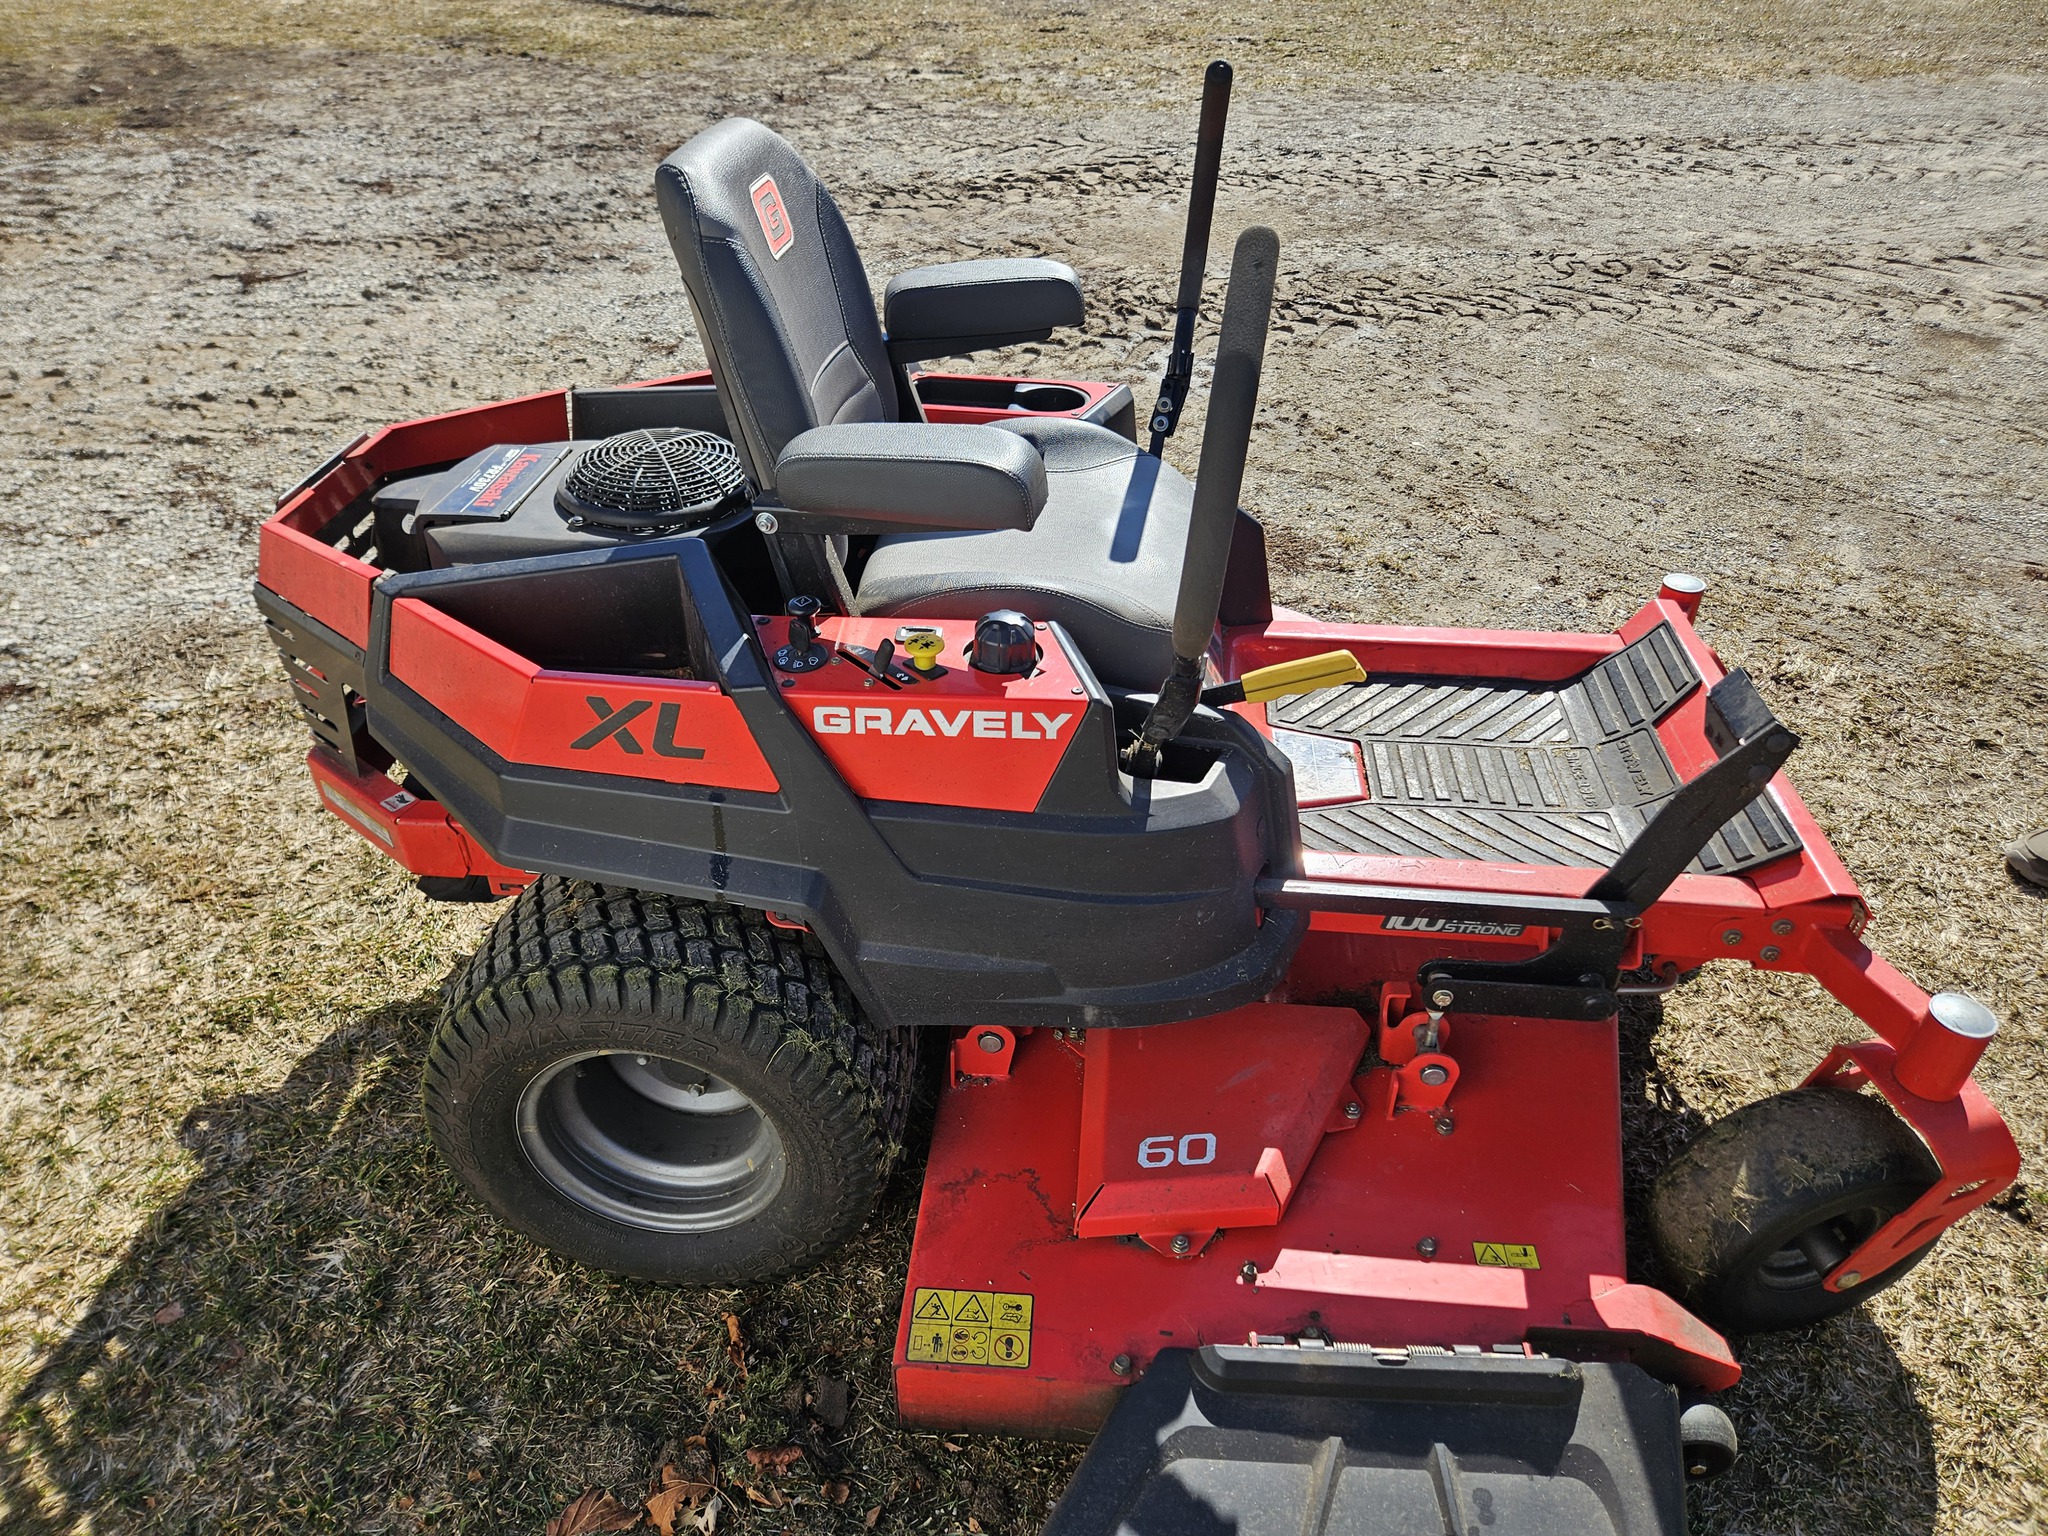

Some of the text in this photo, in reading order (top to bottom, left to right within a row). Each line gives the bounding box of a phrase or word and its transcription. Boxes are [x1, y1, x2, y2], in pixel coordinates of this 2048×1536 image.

[473, 453, 542, 507] Kawasaki
[570, 696, 706, 760] XL
[812, 705, 1073, 741] GRAVELY
[1442, 923, 1523, 936] STRONG
[1137, 1132, 1217, 1169] 60
